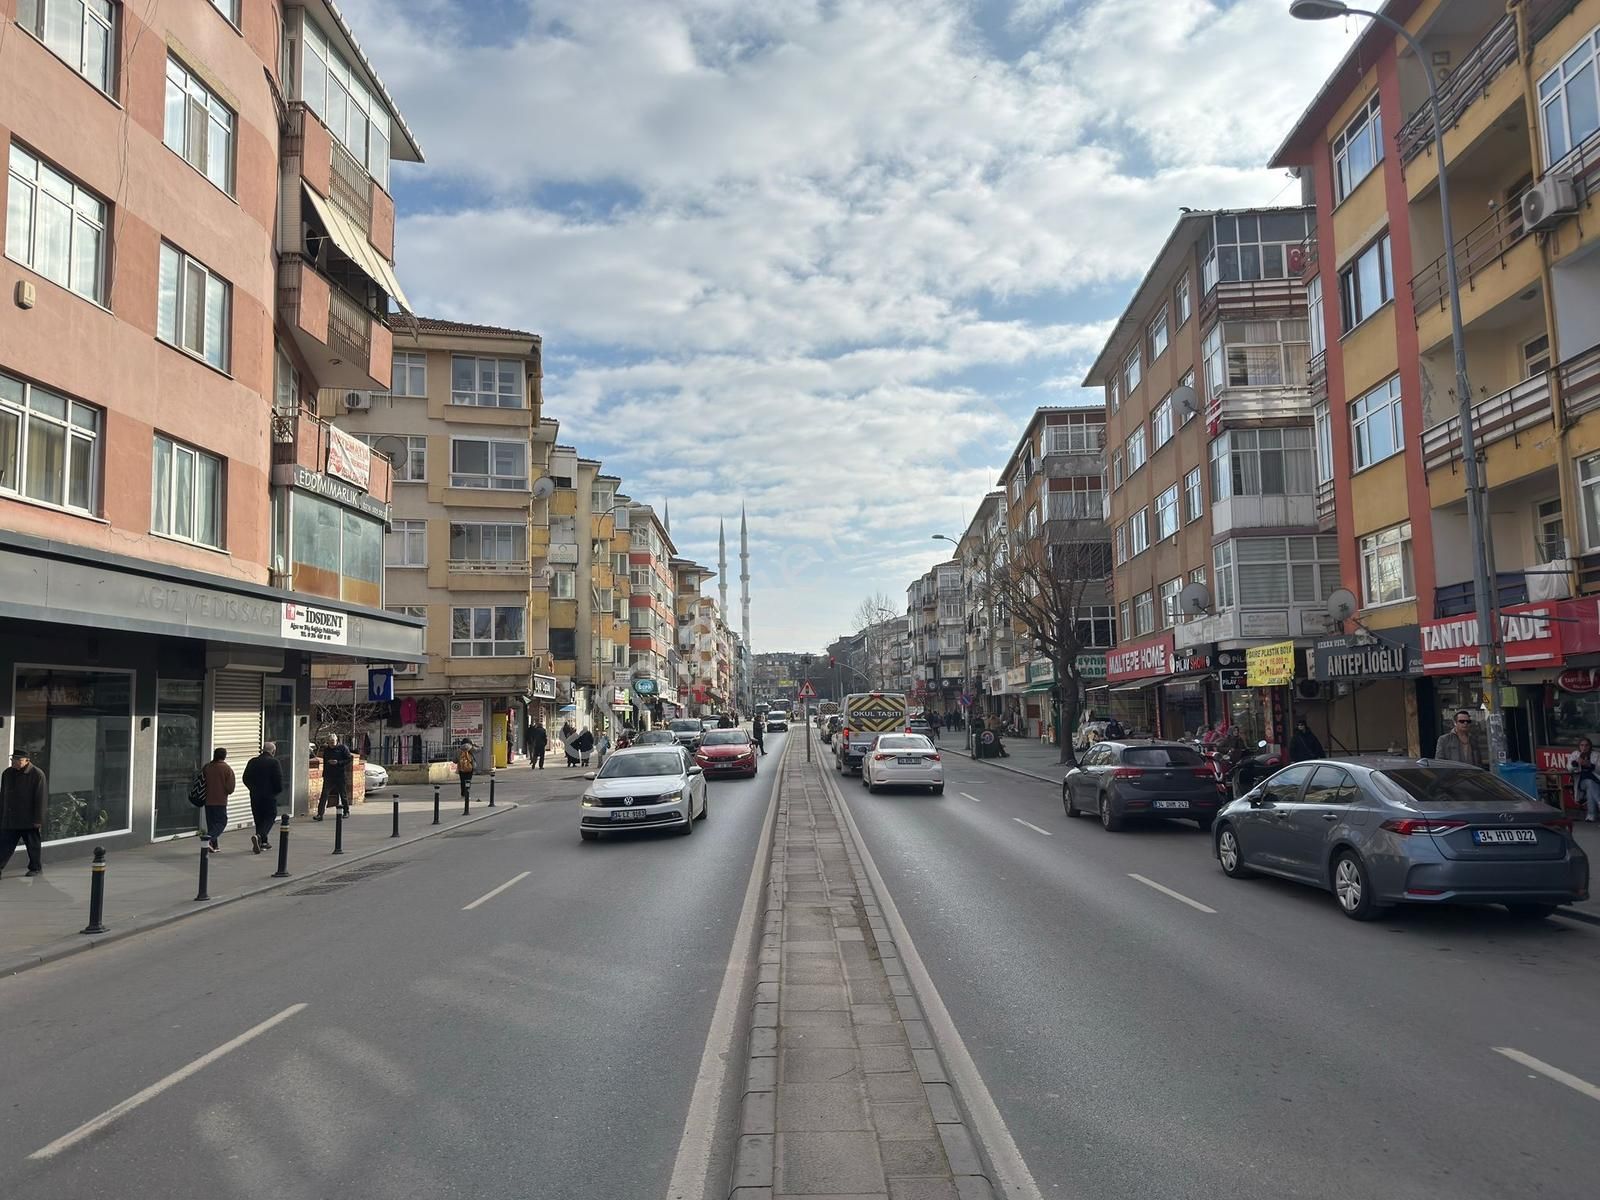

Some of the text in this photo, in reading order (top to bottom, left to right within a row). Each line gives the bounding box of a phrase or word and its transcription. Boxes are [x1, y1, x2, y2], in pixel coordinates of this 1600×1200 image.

[306, 607, 344, 628] İDSDENT
[1109, 645, 1165, 673] MALTEPE HOME
[1328, 645, 1404, 676] ANTEPLİOĞLU
[1480, 831, 1534, 841] 34 HTO 022
